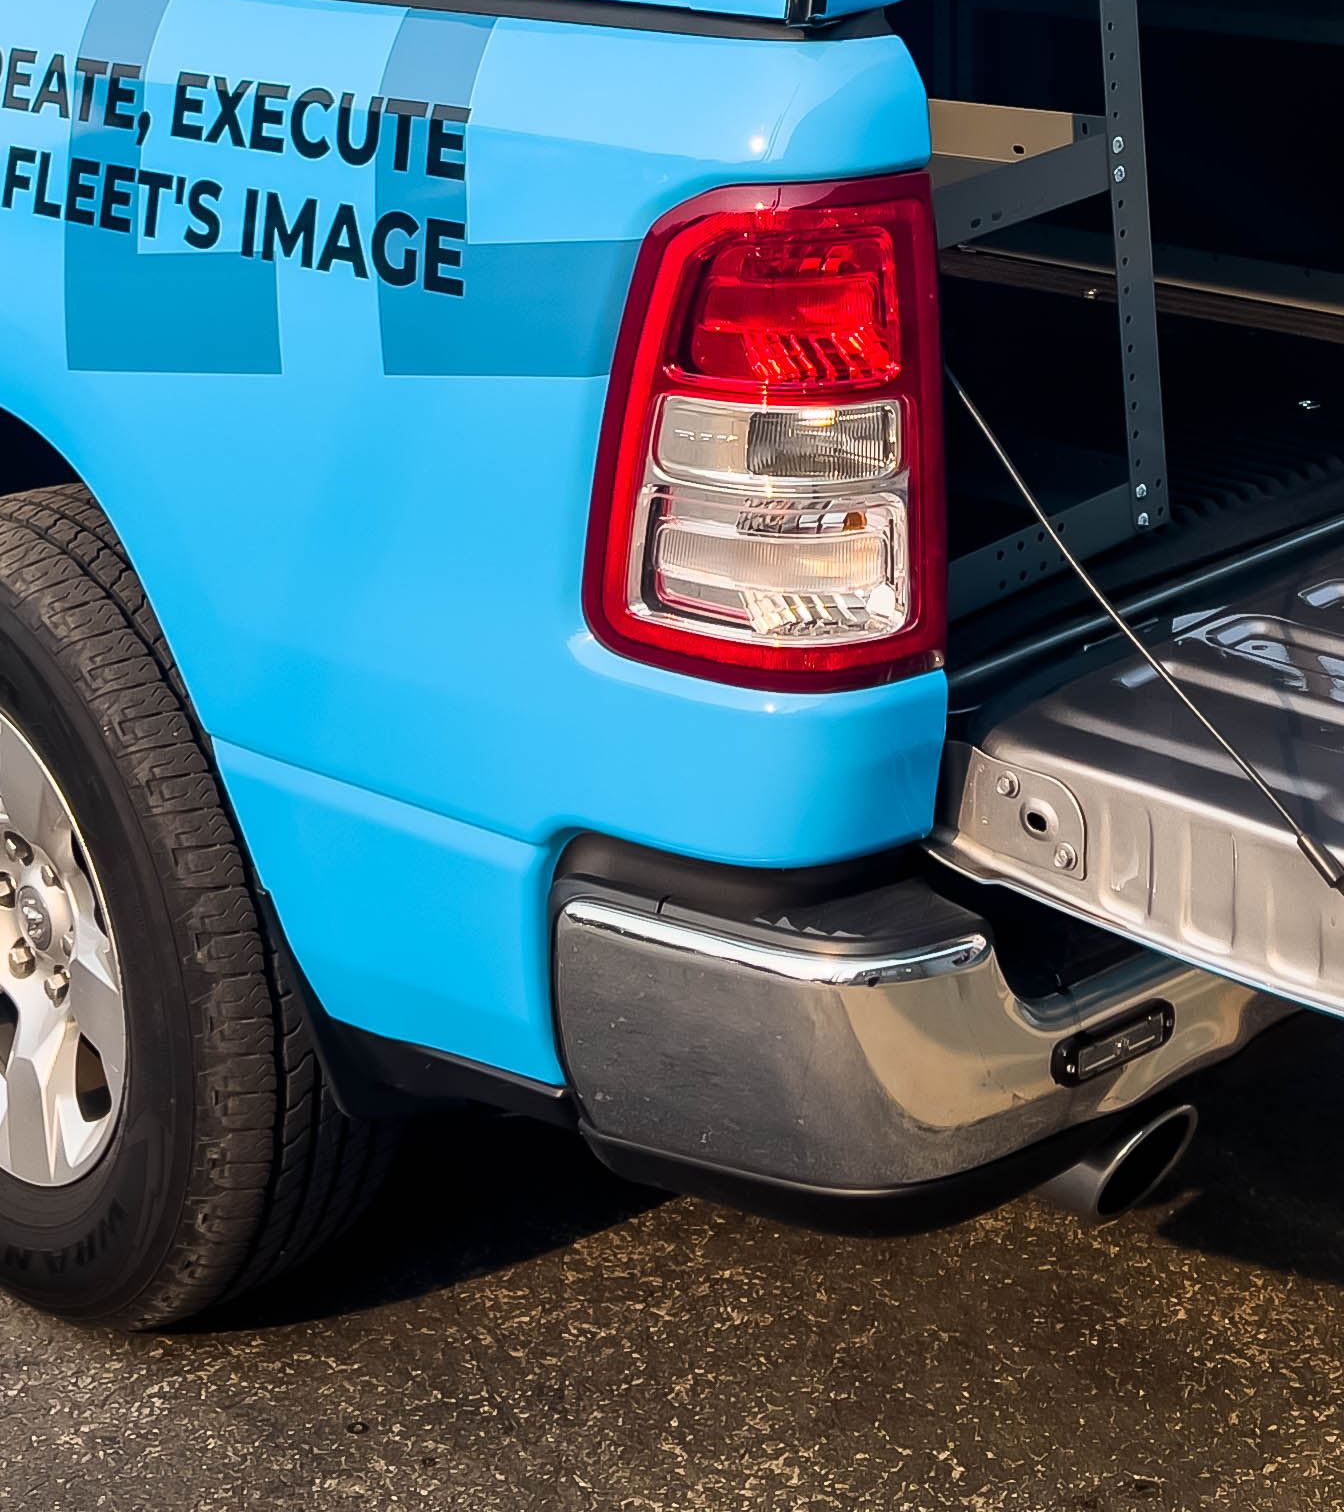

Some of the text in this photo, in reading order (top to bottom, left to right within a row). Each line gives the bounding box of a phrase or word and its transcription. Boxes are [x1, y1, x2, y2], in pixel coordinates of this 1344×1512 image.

[170, 71, 472, 181] EXECUTE
[1, 145, 223, 250] FLEET'S
[241, 188, 466, 298] IMAGE
